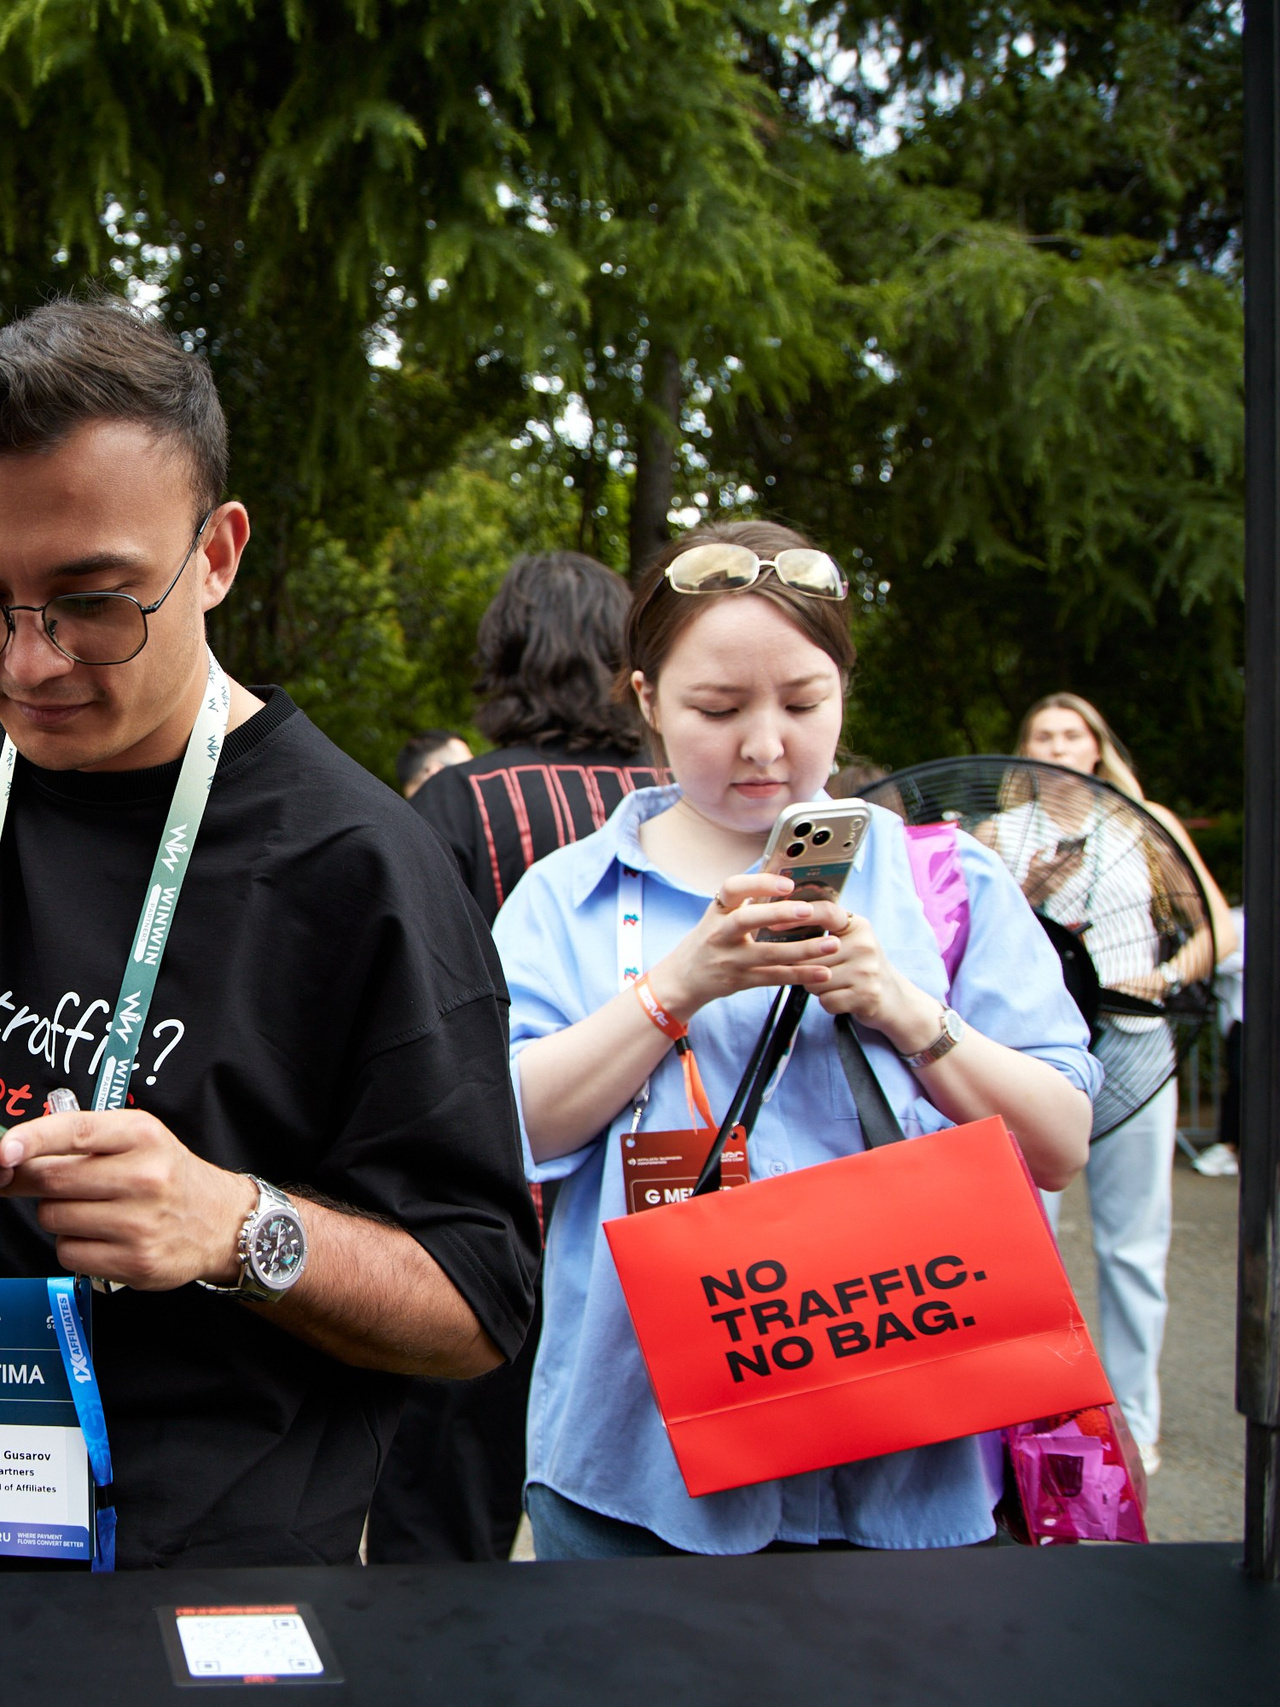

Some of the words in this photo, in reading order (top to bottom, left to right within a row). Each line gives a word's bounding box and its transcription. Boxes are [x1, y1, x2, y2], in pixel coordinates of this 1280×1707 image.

[140, 903, 155, 943] PARTNERS
[144, 886, 177, 965] WINWIN
[645, 1189, 661, 1204] G
[700, 1259, 787, 1307] NO
[711, 1255, 987, 1342] TRAFFIC.
[725, 1336, 814, 1383] NO
[826, 1300, 976, 1359] BAG.
[4, 1450, 51, 1461] Gusarov
[4, 1483, 14, 1491] of
[16, 1484, 57, 1493] Affiliates
